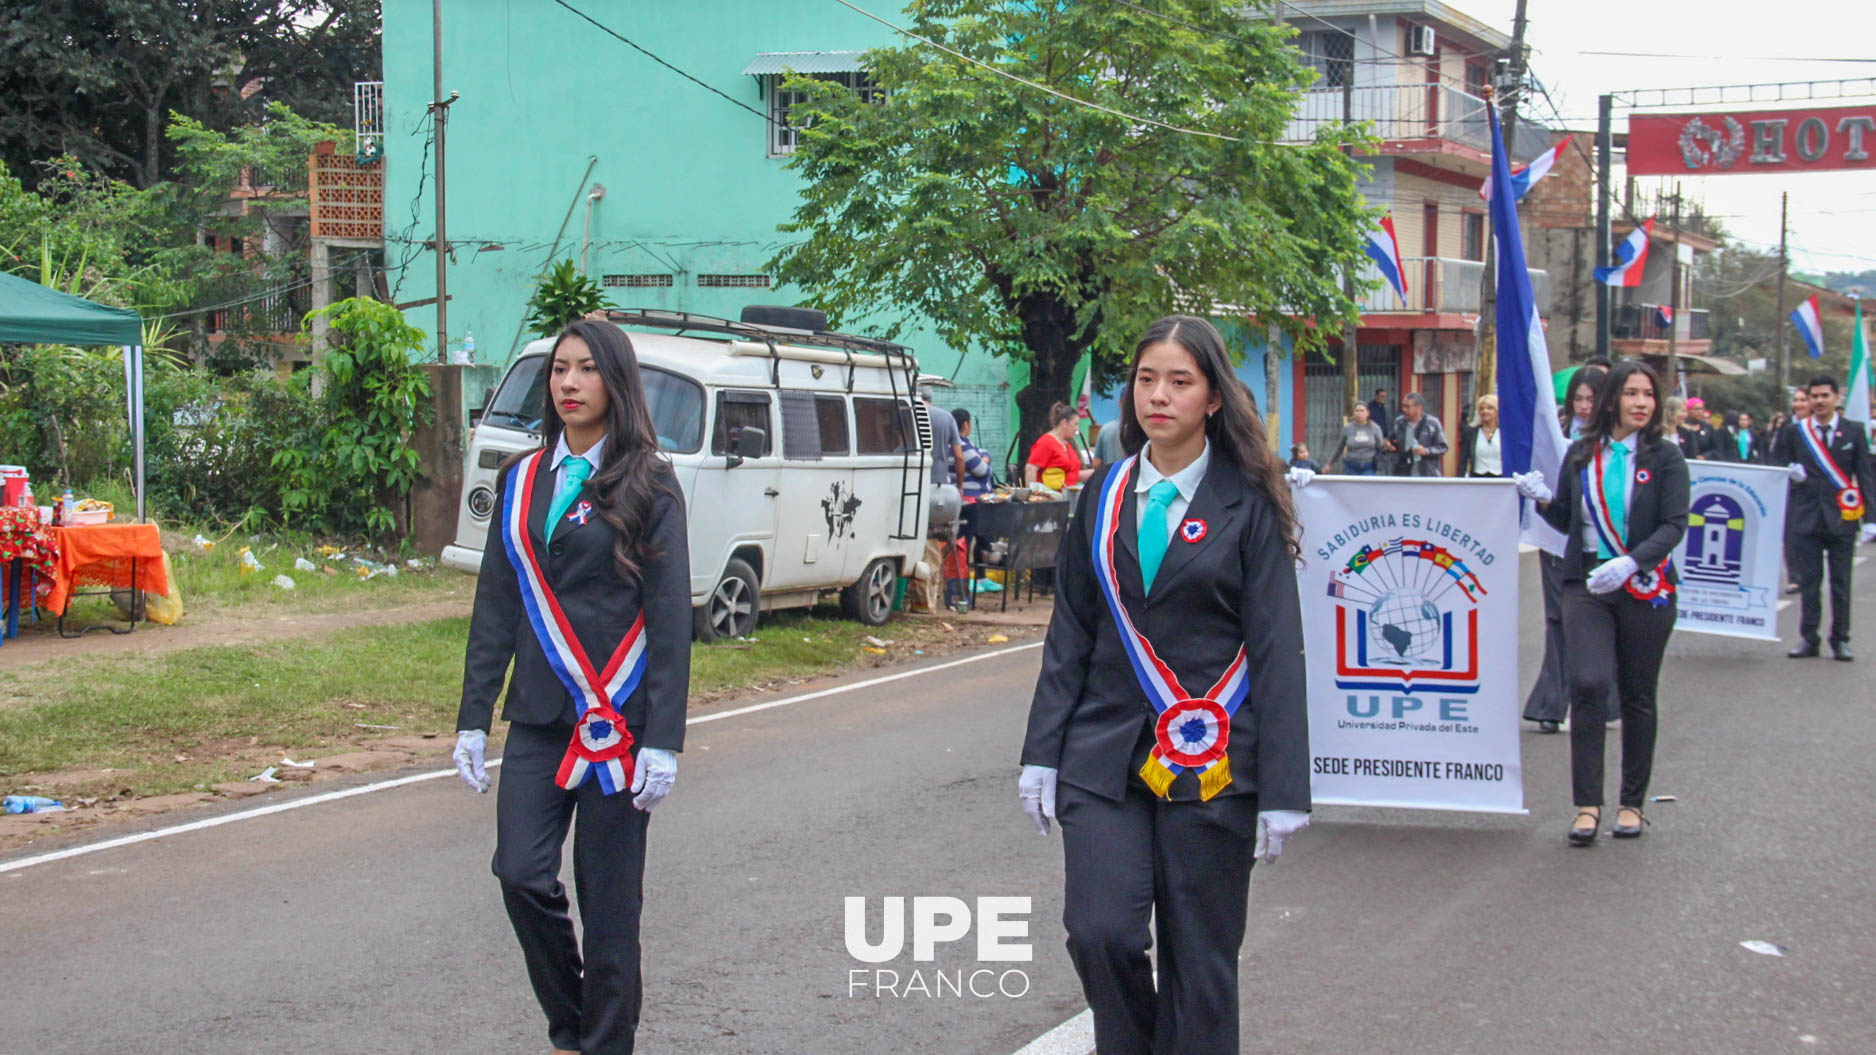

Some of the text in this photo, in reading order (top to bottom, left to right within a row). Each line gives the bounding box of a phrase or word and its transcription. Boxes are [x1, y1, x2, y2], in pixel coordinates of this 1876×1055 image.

[1749, 116, 1876, 163] HOT
[1318, 513, 1495, 566] SABIDURIA ES LIBERTAD
[1691, 611, 1734, 624] PRESIDENTE
[1736, 615, 1765, 627] FRANCO
[1338, 720, 1479, 733] Universidad Privada del Este
[1314, 757, 1503, 781] SEDE PRESIDENTE FRANCO
